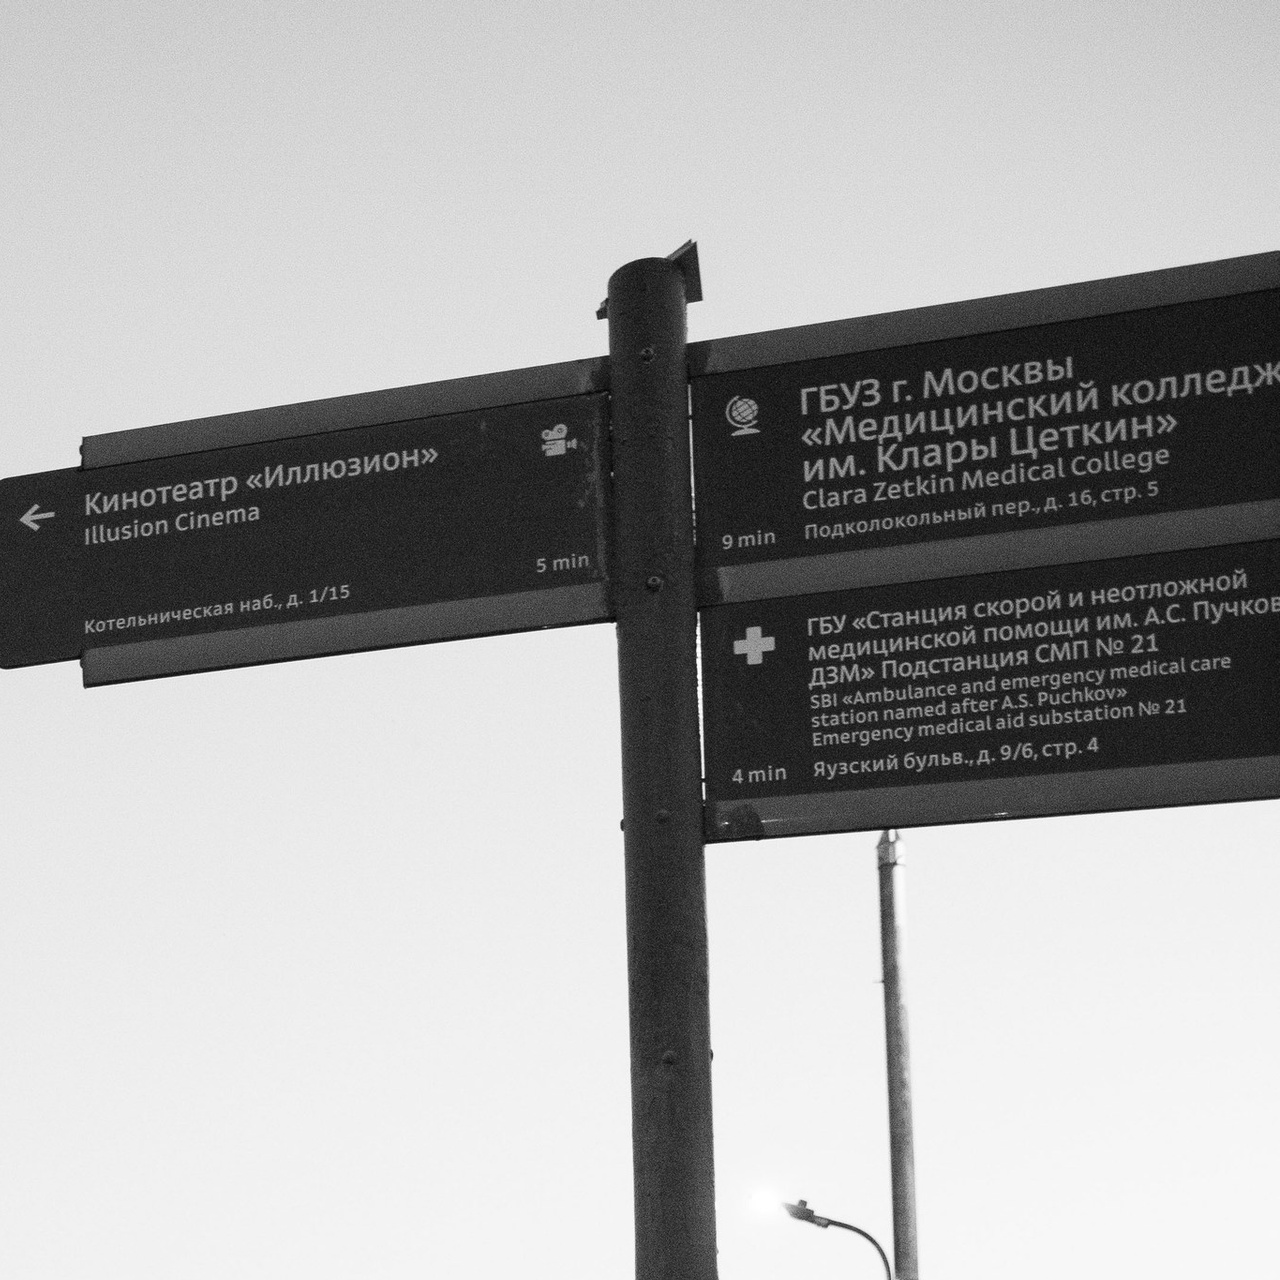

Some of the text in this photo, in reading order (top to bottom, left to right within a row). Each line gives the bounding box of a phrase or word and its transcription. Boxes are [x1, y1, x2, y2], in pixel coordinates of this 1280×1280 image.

[800, 356, 1073, 415] ГБУЗ г. Москвы
[801, 362, 1280, 446] «Медицинский колледж
[803, 414, 1177, 482] им. Клары Цеткин»
[85, 448, 439, 516] Кинотеатр «Иллюзион»
[802, 448, 1170, 510] Clara Zetkin Medical College
[84, 506, 260, 545] Illusion Cinema
[805, 502, 986, 539] Подколокольный
[1069, 489, 1097, 507] 16,
[1101, 486, 1144, 504] стр.
[1148, 481, 1158, 497] 5
[536, 553, 589, 573] 5 min
[722, 532, 776, 550] 9 min
[84, 602, 234, 634] Котельническая
[310, 584, 350, 603] 1/15
[807, 569, 1247, 636] ГБУ «Станция скорой и неотложной
[808, 625, 976, 661] медицинской
[983, 617, 1089, 643] помощи
[1096, 612, 1138, 631] им.
[1144, 603, 1186, 626] А.С.
[808, 633, 1159, 690] ДЗМ» Подстанция СМП № 21
[810, 656, 1231, 709] SBI «Ambulance and emergency medical care
[811, 686, 1127, 728] station named after A.S. Puchkov»
[812, 699, 1186, 747] Emergency medical aid substation № 21
[732, 765, 787, 784] 4 min
[813, 754, 899, 780] Яузский
[1000, 742, 1038, 761] 9/6,
[1041, 741, 1083, 759] стр.
[1087, 737, 1099, 752] 4
